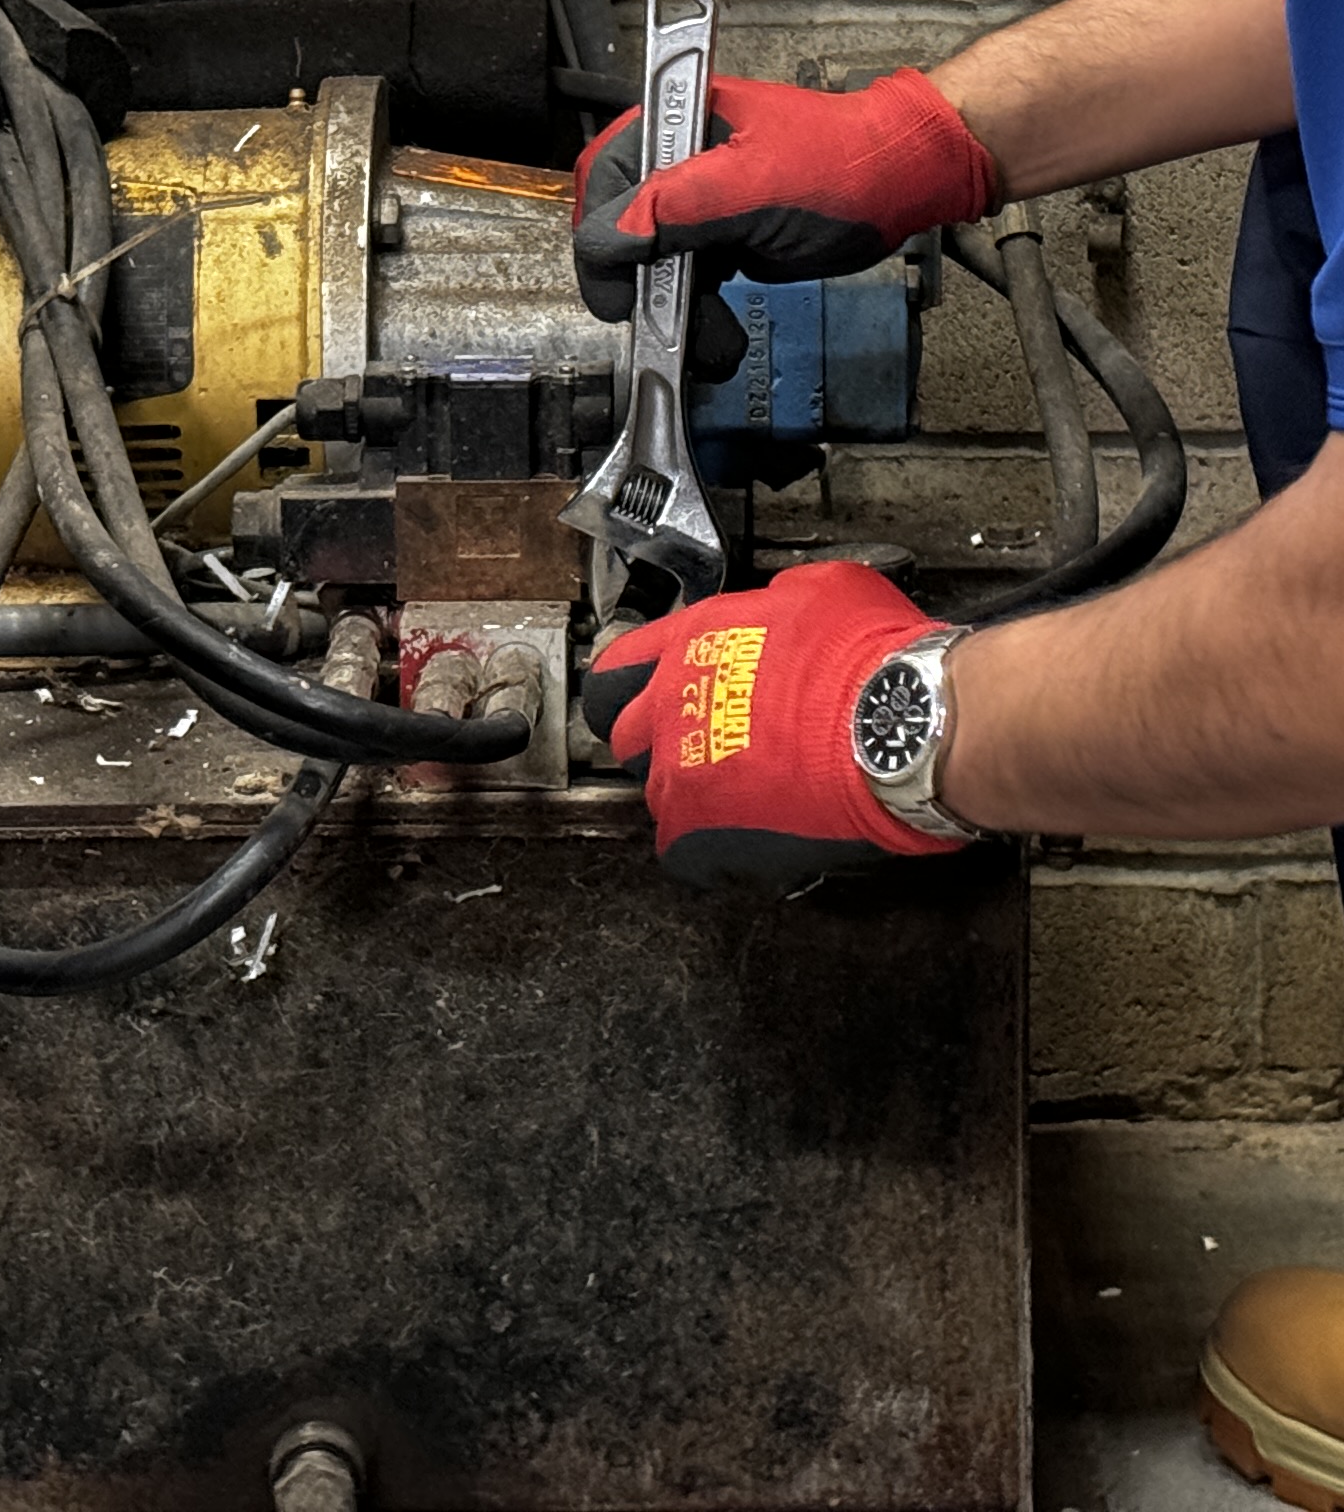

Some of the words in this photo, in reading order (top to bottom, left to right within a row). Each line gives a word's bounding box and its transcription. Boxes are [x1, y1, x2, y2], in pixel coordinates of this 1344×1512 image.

[664, 78, 687, 126] 250
[661, 129, 675, 165] mm
[721, 626, 768, 752] KOMFORT
